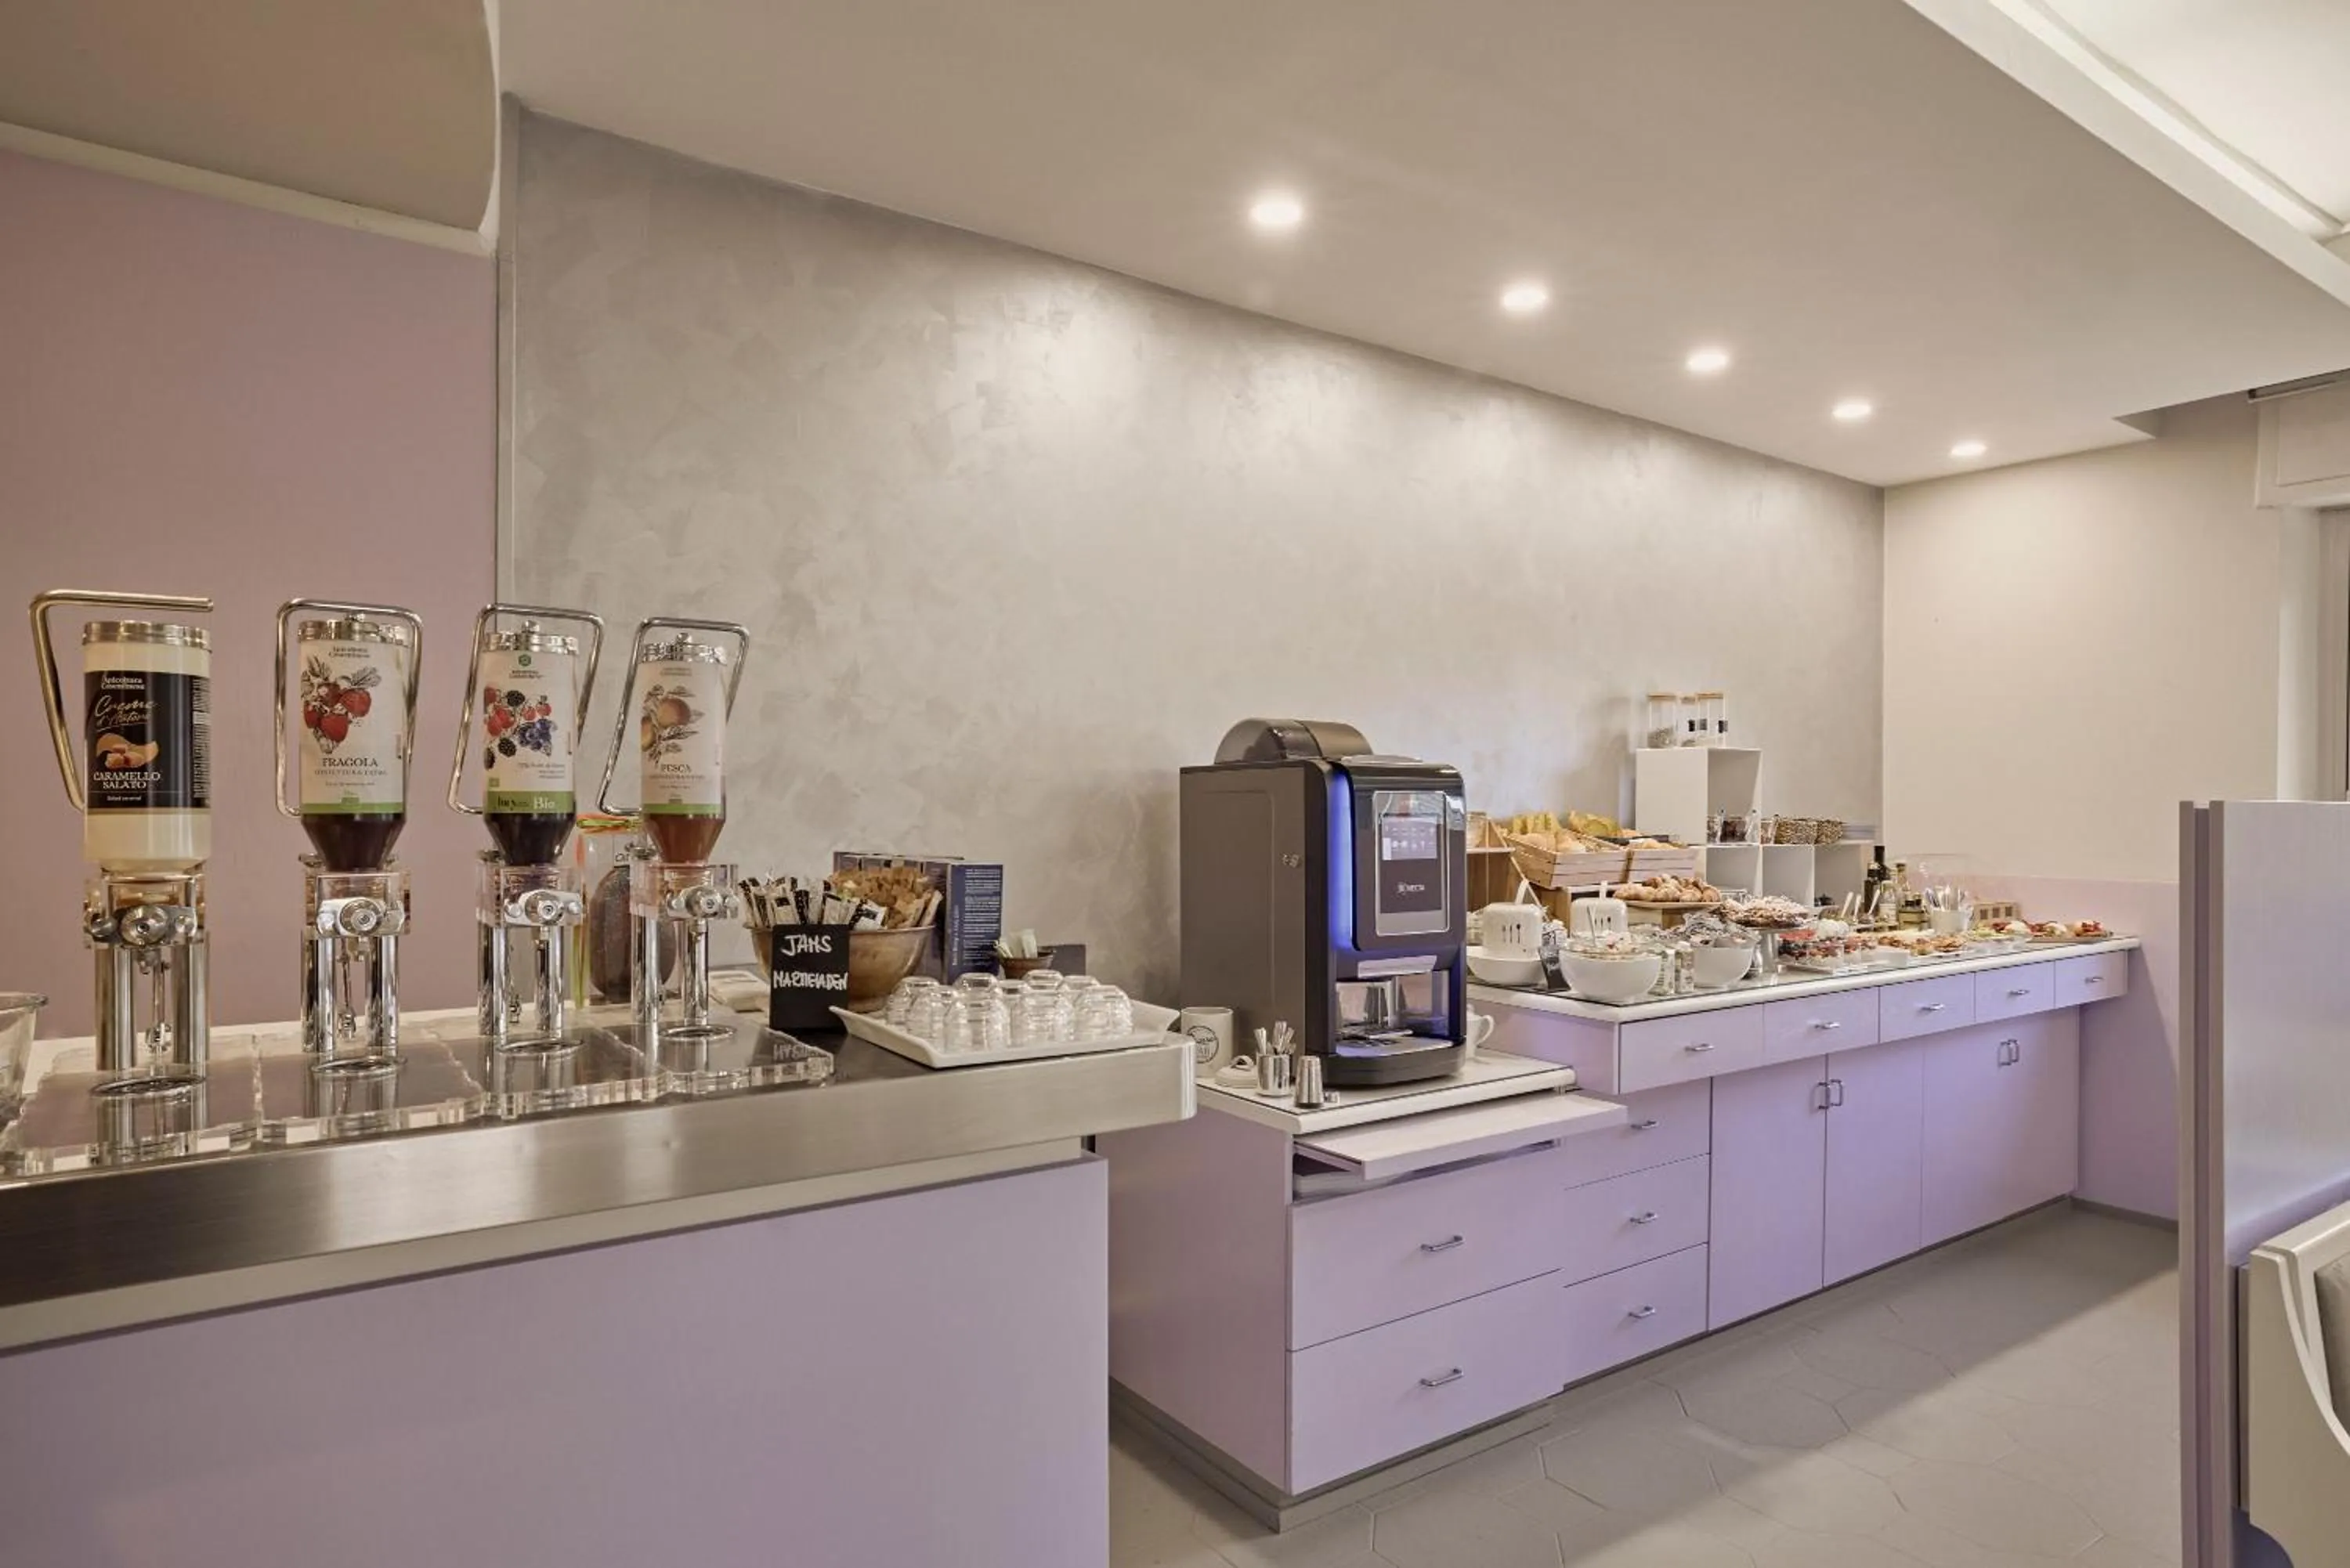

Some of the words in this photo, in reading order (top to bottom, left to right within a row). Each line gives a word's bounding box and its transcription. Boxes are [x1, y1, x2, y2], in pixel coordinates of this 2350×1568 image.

[322, 757, 378, 767] FRAGOLA
[93, 771, 161, 781] CARAMELLO
[103, 781, 146, 789] SALATO
[781, 934, 832, 956] JAMS
